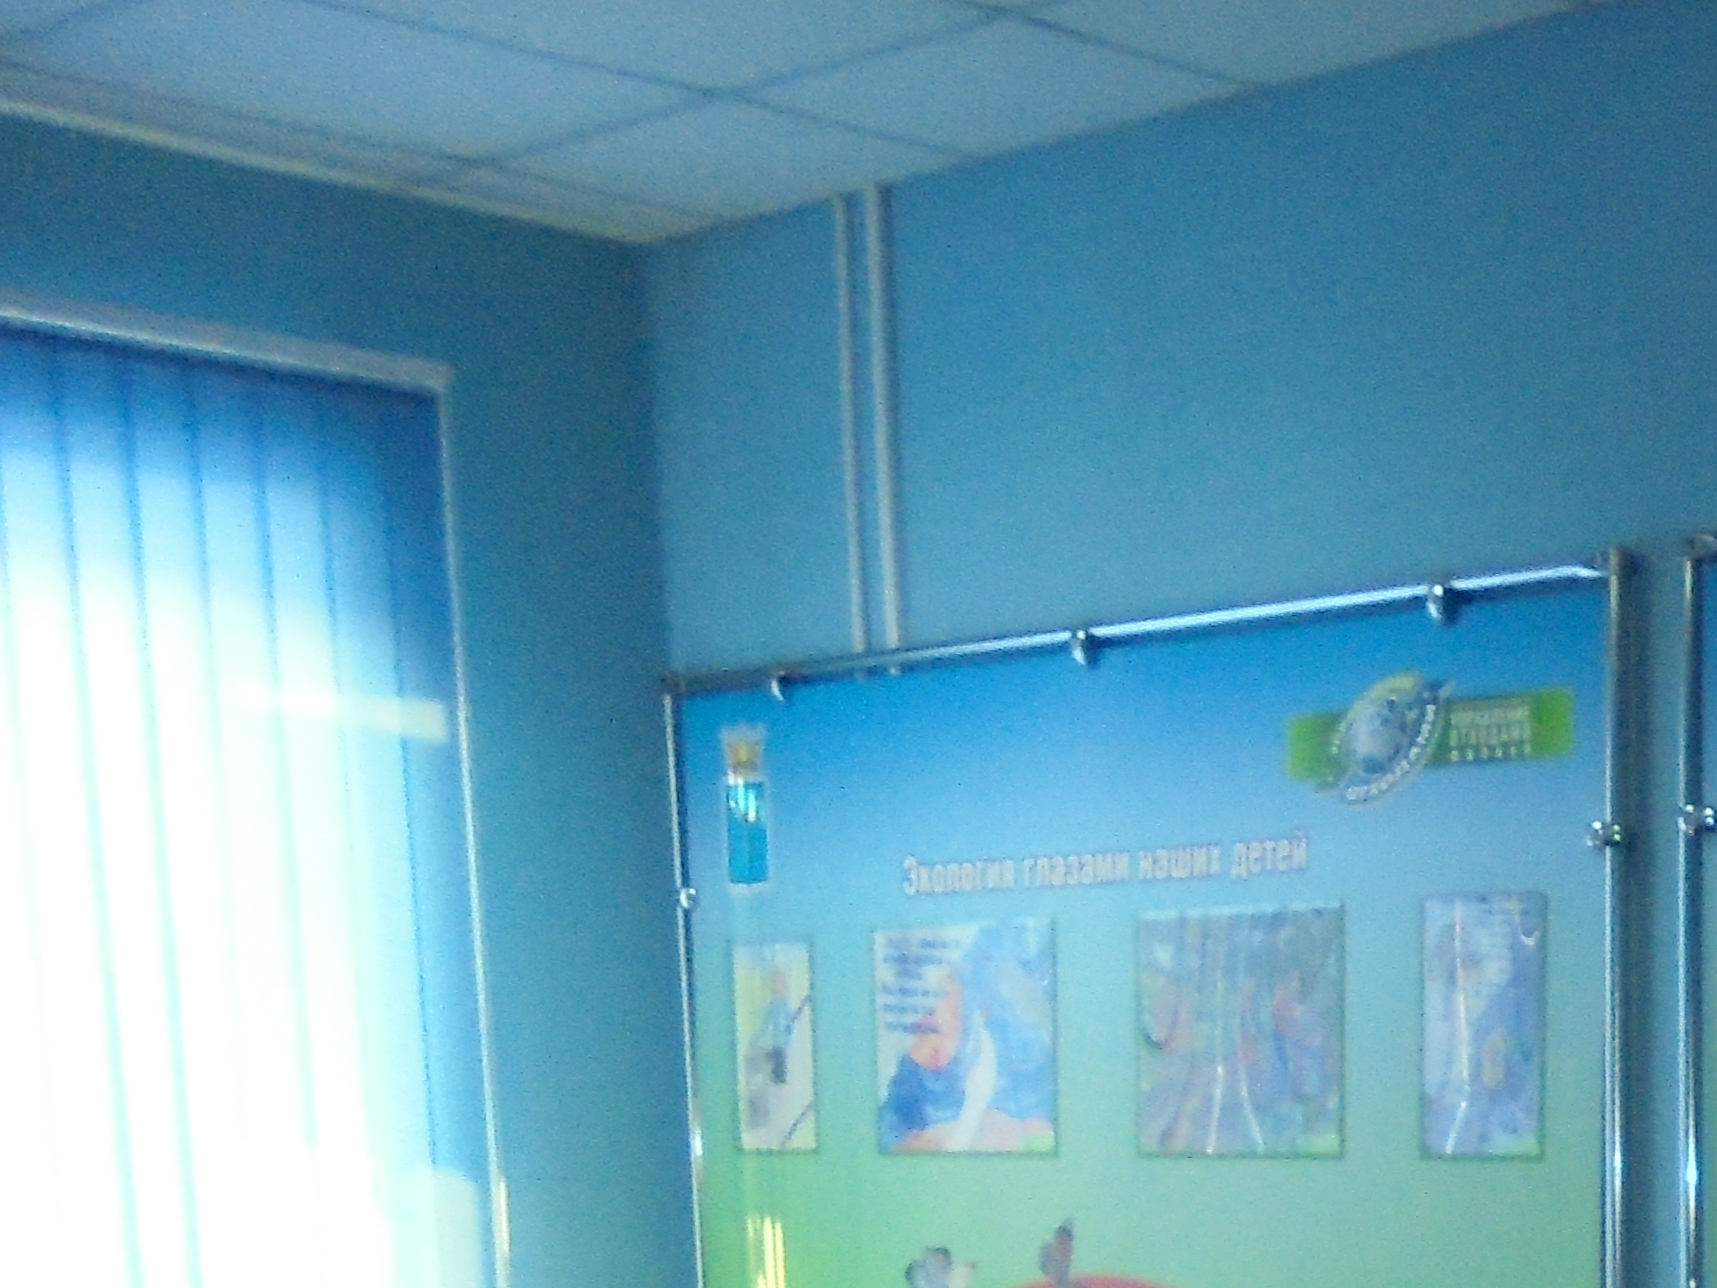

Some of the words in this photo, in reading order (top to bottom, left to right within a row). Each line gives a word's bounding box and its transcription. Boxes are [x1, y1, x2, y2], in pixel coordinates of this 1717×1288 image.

[903, 854, 1015, 896] Экология
[1023, 852, 1130, 888] глазами
[1139, 842, 1222, 880] наших
[1230, 830, 1309, 880] детей
